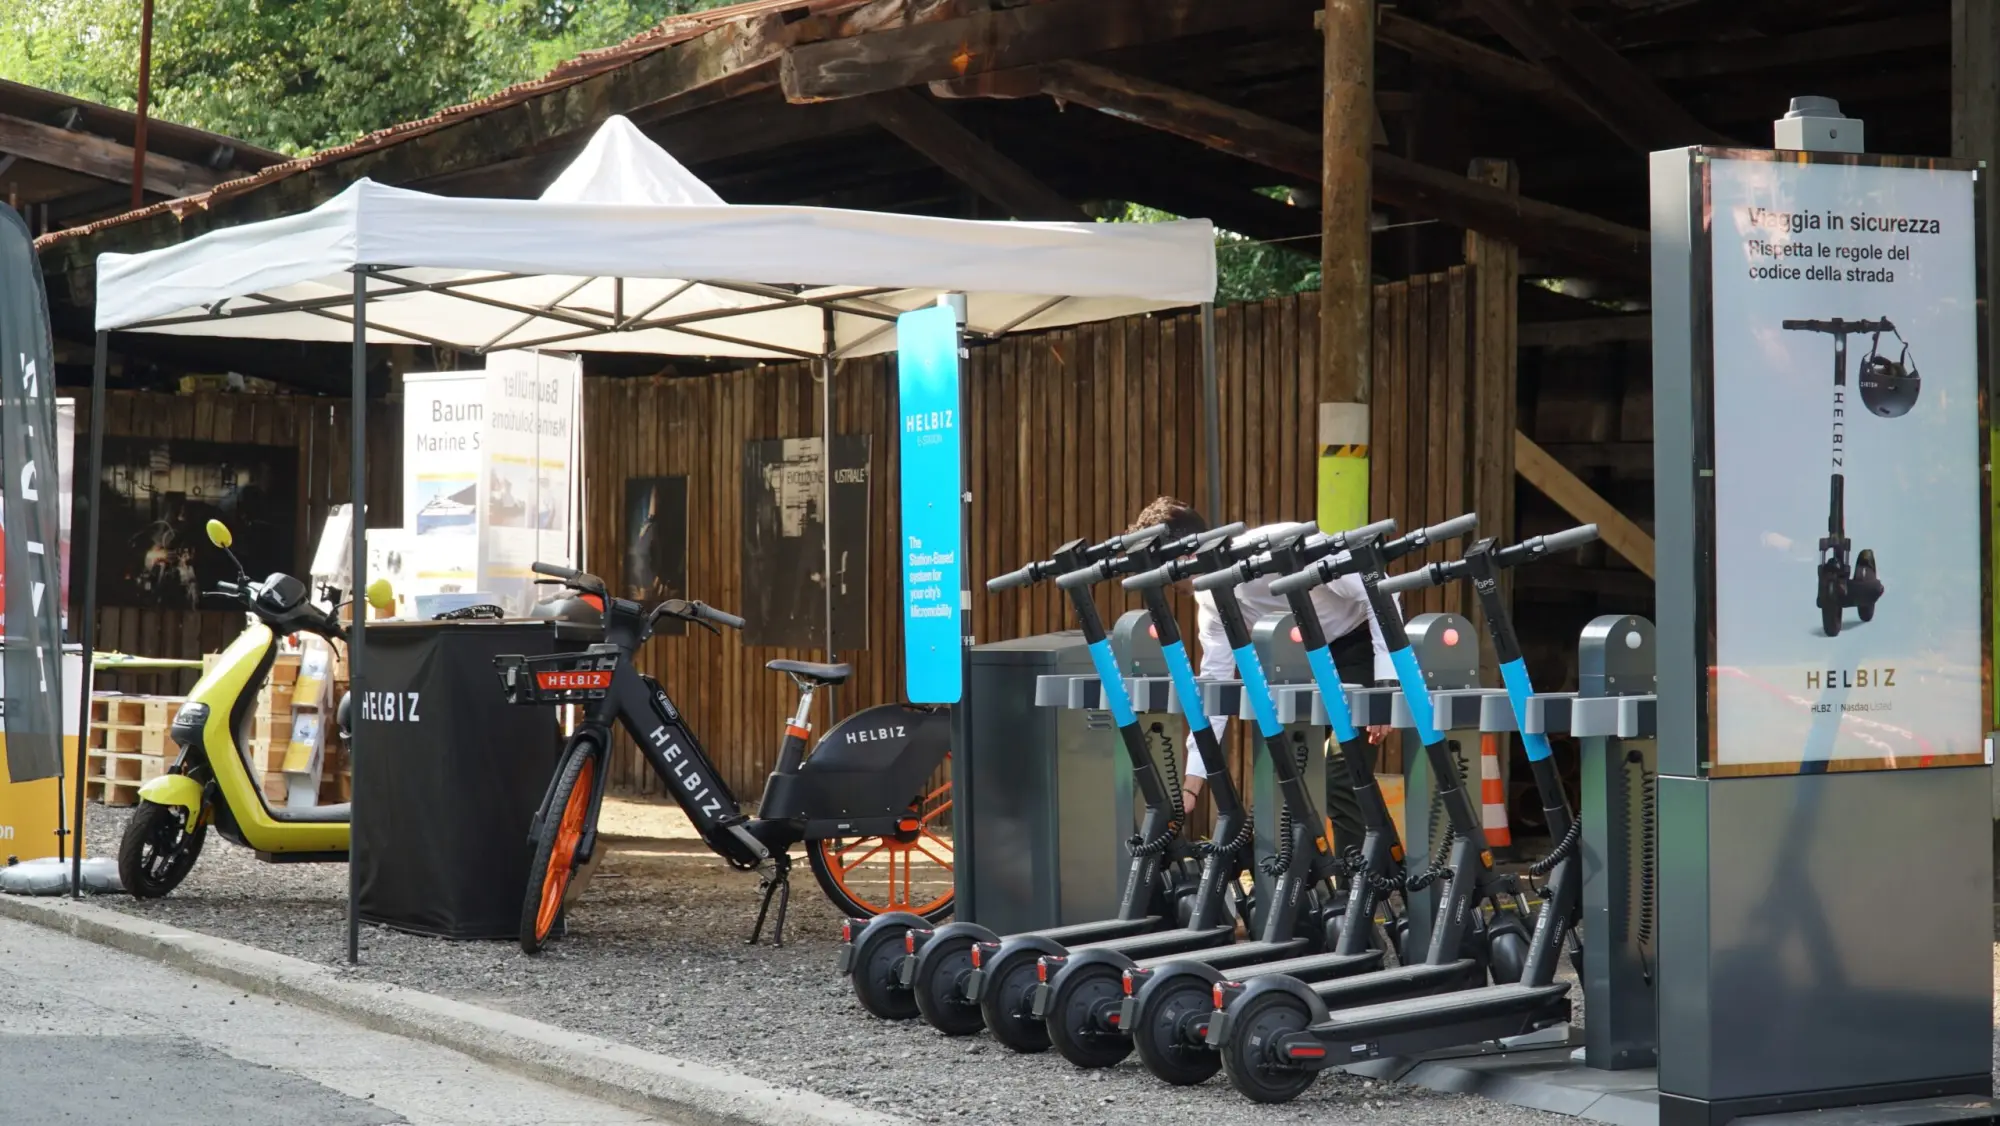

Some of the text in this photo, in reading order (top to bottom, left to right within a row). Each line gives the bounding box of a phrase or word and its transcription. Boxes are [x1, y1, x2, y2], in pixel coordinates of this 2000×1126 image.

[1748, 208, 1941, 234] Viaggia in sicurezza
[1748, 240, 1910, 262] Rispetta le regole del
[1749, 264, 1894, 283] codice della strada
[432, 399, 483, 422] Baum
[906, 409, 953, 433] HELBIZ
[1832, 392, 1844, 468] HELBIZ
[417, 431, 480, 452] Marine S
[908, 536, 922, 549] The
[908, 551, 954, 567] Station-Based
[908, 568, 942, 584] system for
[1363, 571, 1380, 582] GPS
[1477, 578, 1495, 589] GPS
[548, 675, 601, 686] HELBIZ
[1807, 668, 1896, 689] HELBIZ
[362, 691, 420, 722] HELBIZ
[1811, 703, 1832, 713] HLBZ
[1840, 702, 1869, 713] Nasdaq
[845, 725, 906, 744] HELBIZ
[649, 725, 722, 818] HELBIZ
